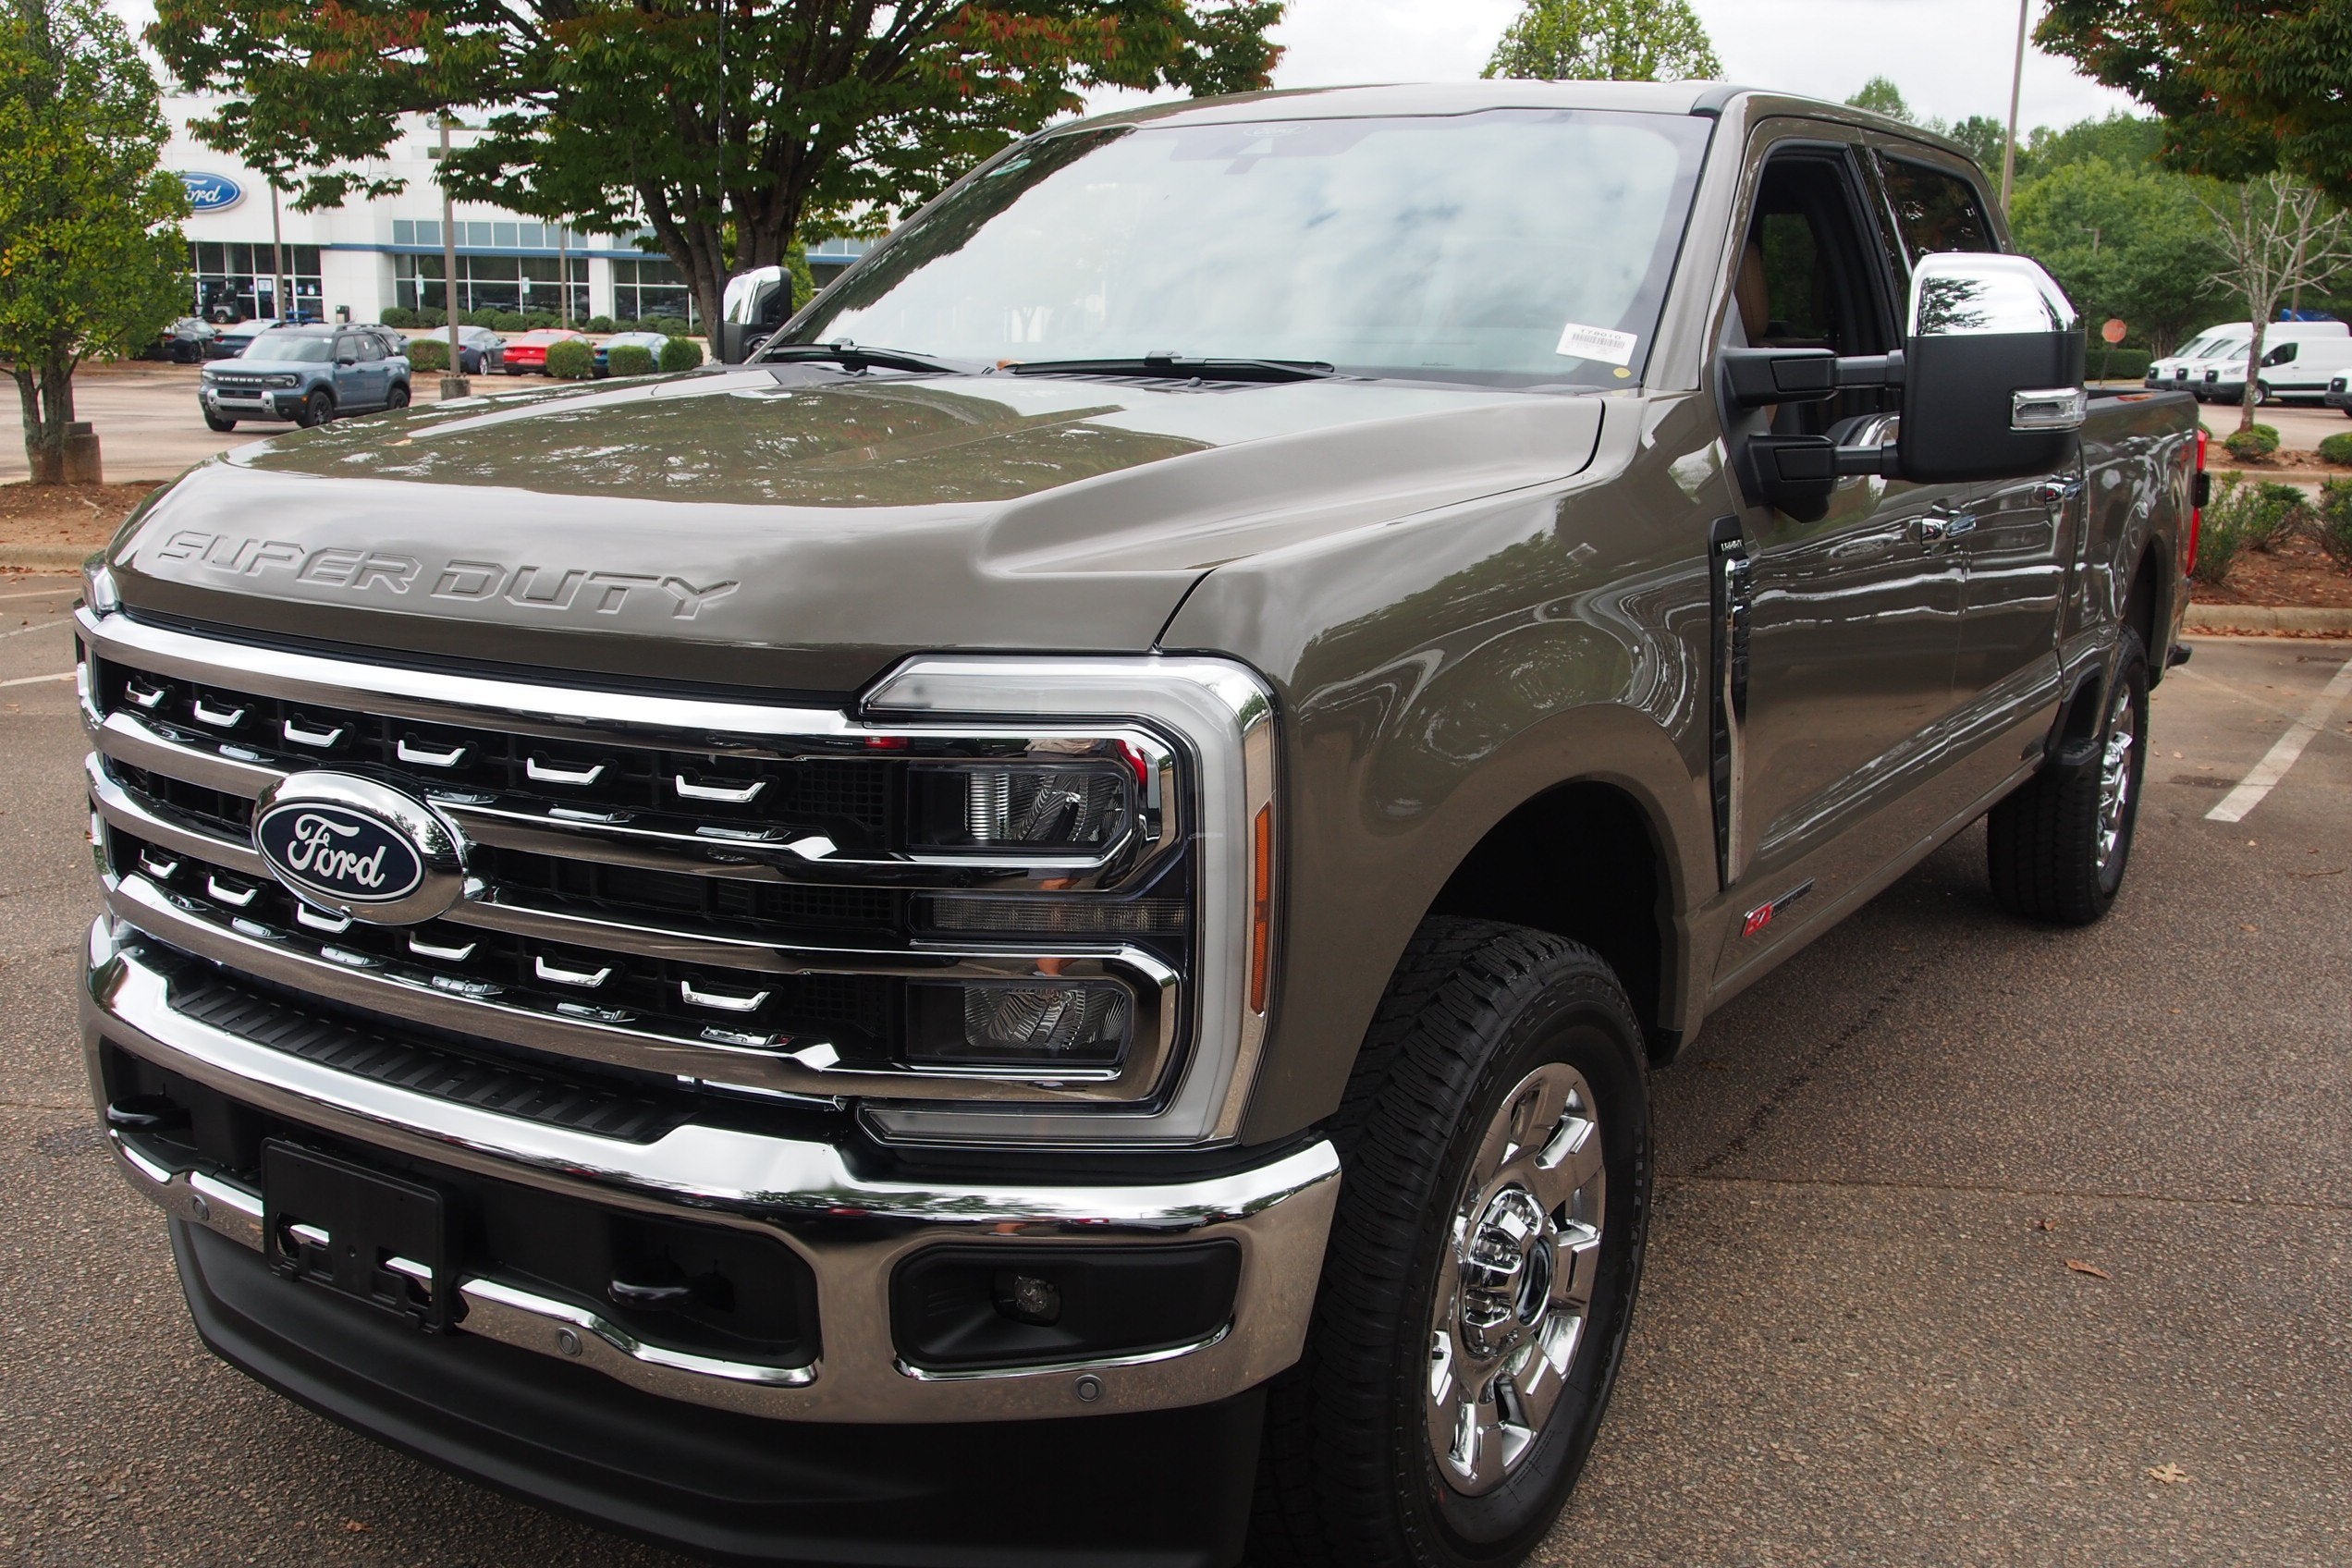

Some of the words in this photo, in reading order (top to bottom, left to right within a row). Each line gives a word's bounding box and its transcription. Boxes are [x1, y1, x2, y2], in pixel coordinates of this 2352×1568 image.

[158, 531, 423, 594] SUPER
[430, 560, 741, 620] DUTY
[288, 814, 386, 888] Ford
